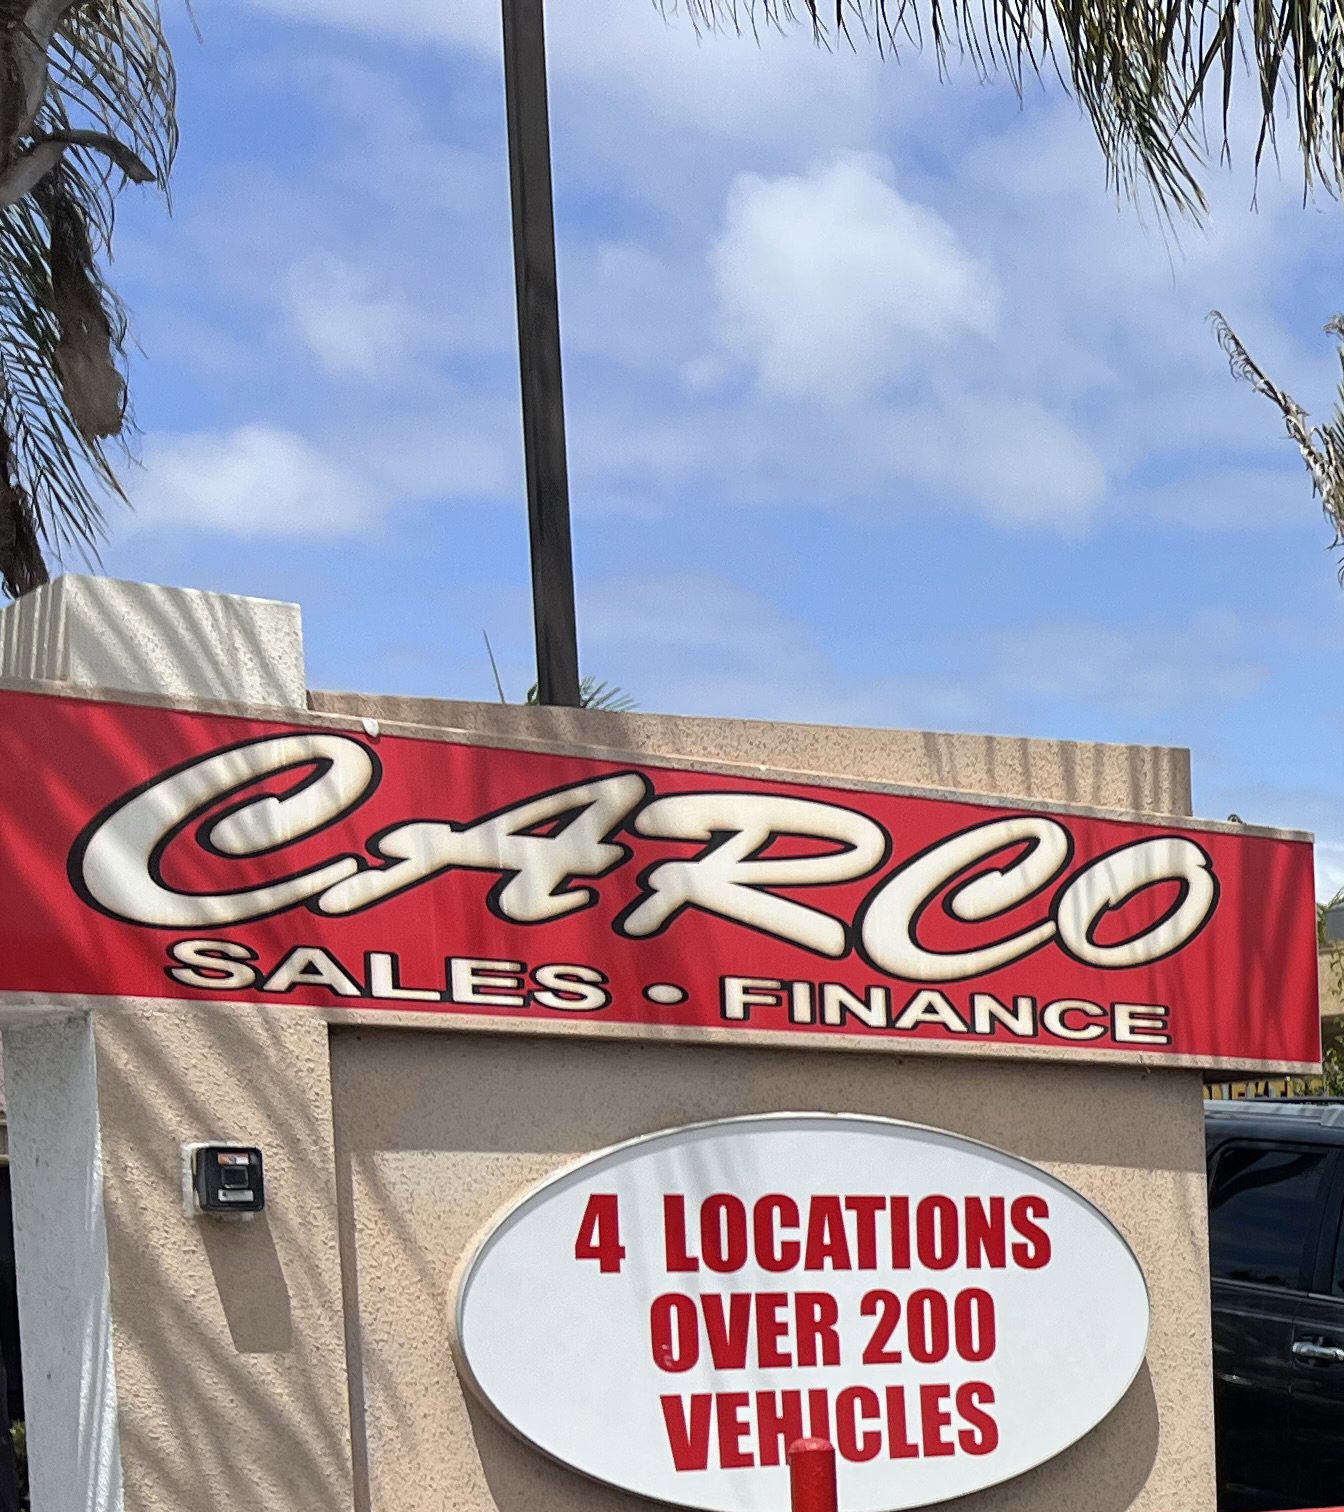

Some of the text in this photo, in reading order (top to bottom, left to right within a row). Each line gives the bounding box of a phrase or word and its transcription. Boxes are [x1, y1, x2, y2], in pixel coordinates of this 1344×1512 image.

[68, 732, 1219, 983] CARCO
[166, 939, 1173, 1046] SALES FINANCE
[575, 1193, 1051, 1273] 4 LOCATIONS
[650, 1288, 996, 1372] OVER 200
[659, 1381, 1000, 1471] VEHICLES
